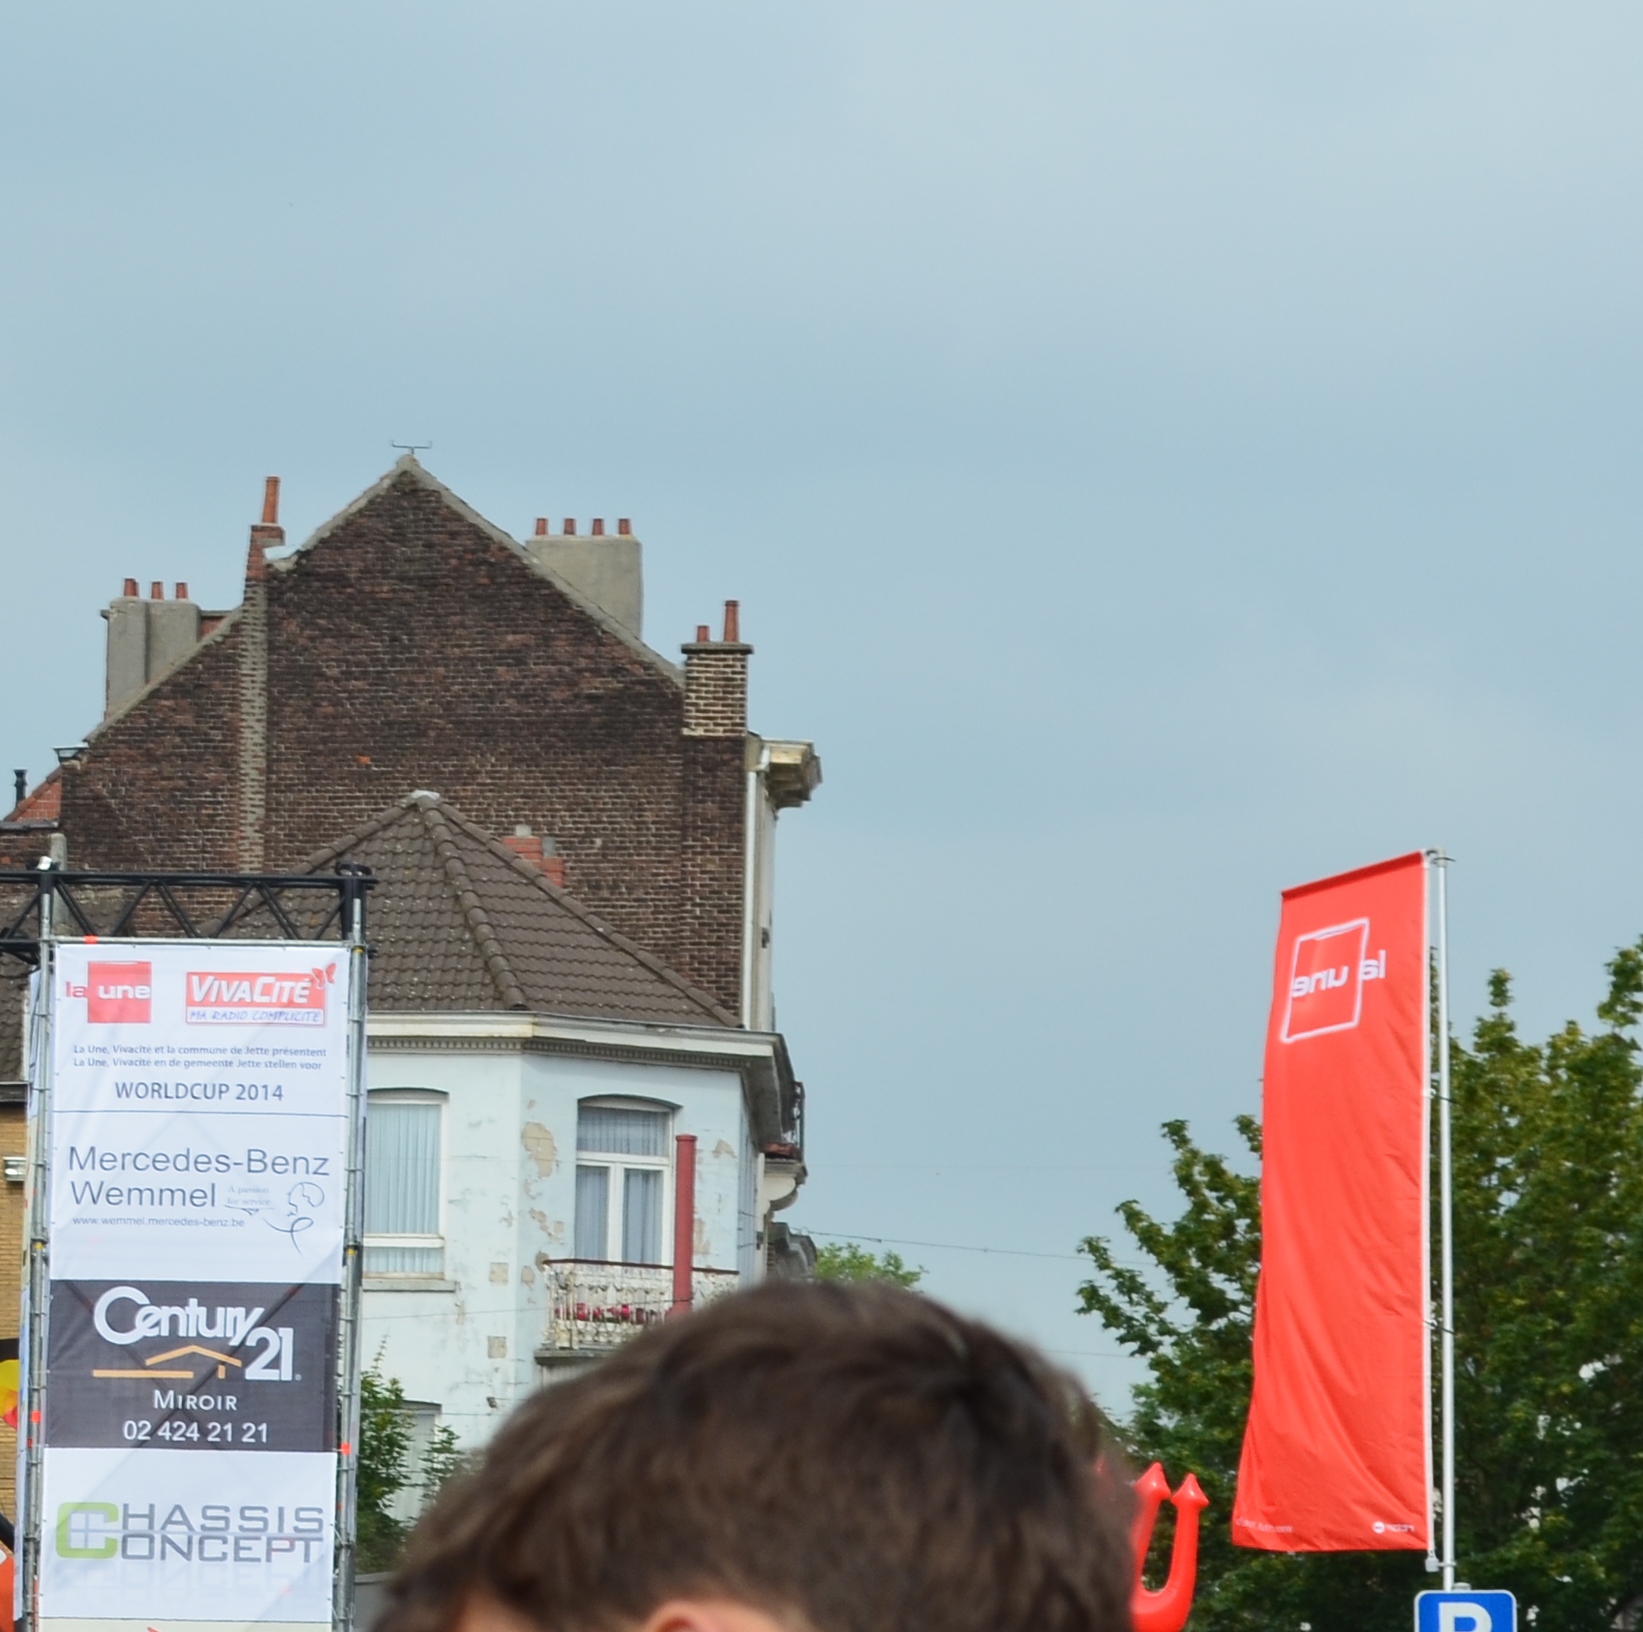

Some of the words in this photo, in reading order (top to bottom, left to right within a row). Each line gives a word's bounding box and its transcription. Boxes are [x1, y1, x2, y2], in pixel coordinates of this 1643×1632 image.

[65, 980, 87, 998] la
[98, 982, 151, 1000] une
[211, 1010, 248, 1021] RADIO
[73, 1044, 85, 1054] La
[154, 1046, 164, 1054] et
[166, 1045, 175, 1054] la
[177, 1046, 228, 1055] commune
[230, 1046, 243, 1055] de
[245, 1046, 270, 1056] Jette
[73, 1058, 85, 1067] La
[154, 1060, 167, 1068] en
[169, 1058, 182, 1068] de
[183, 1059, 234, 1070] gemeente
[237, 1059, 262, 1069] Jette
[264, 1059, 298, 1070] stellen
[299, 1061, 322, 1070] voor
[114, 1081, 230, 1100] WORLDCUP
[235, 1083, 284, 1102] 2014
[68, 1145, 330, 1176] Mercedes-Benz
[70, 1180, 216, 1208] Wemmel
[72, 1216, 245, 1229] www.wemmel.mercedes-benz.be
[93, 1285, 265, 1346] Century
[245, 1327, 295, 1382] 21
[152, 1389, 238, 1412] MIROIR
[123, 1419, 151, 1440] 02
[157, 1420, 200, 1442] 424
[207, 1422, 233, 1442] 21
[241, 1422, 268, 1443] 21
